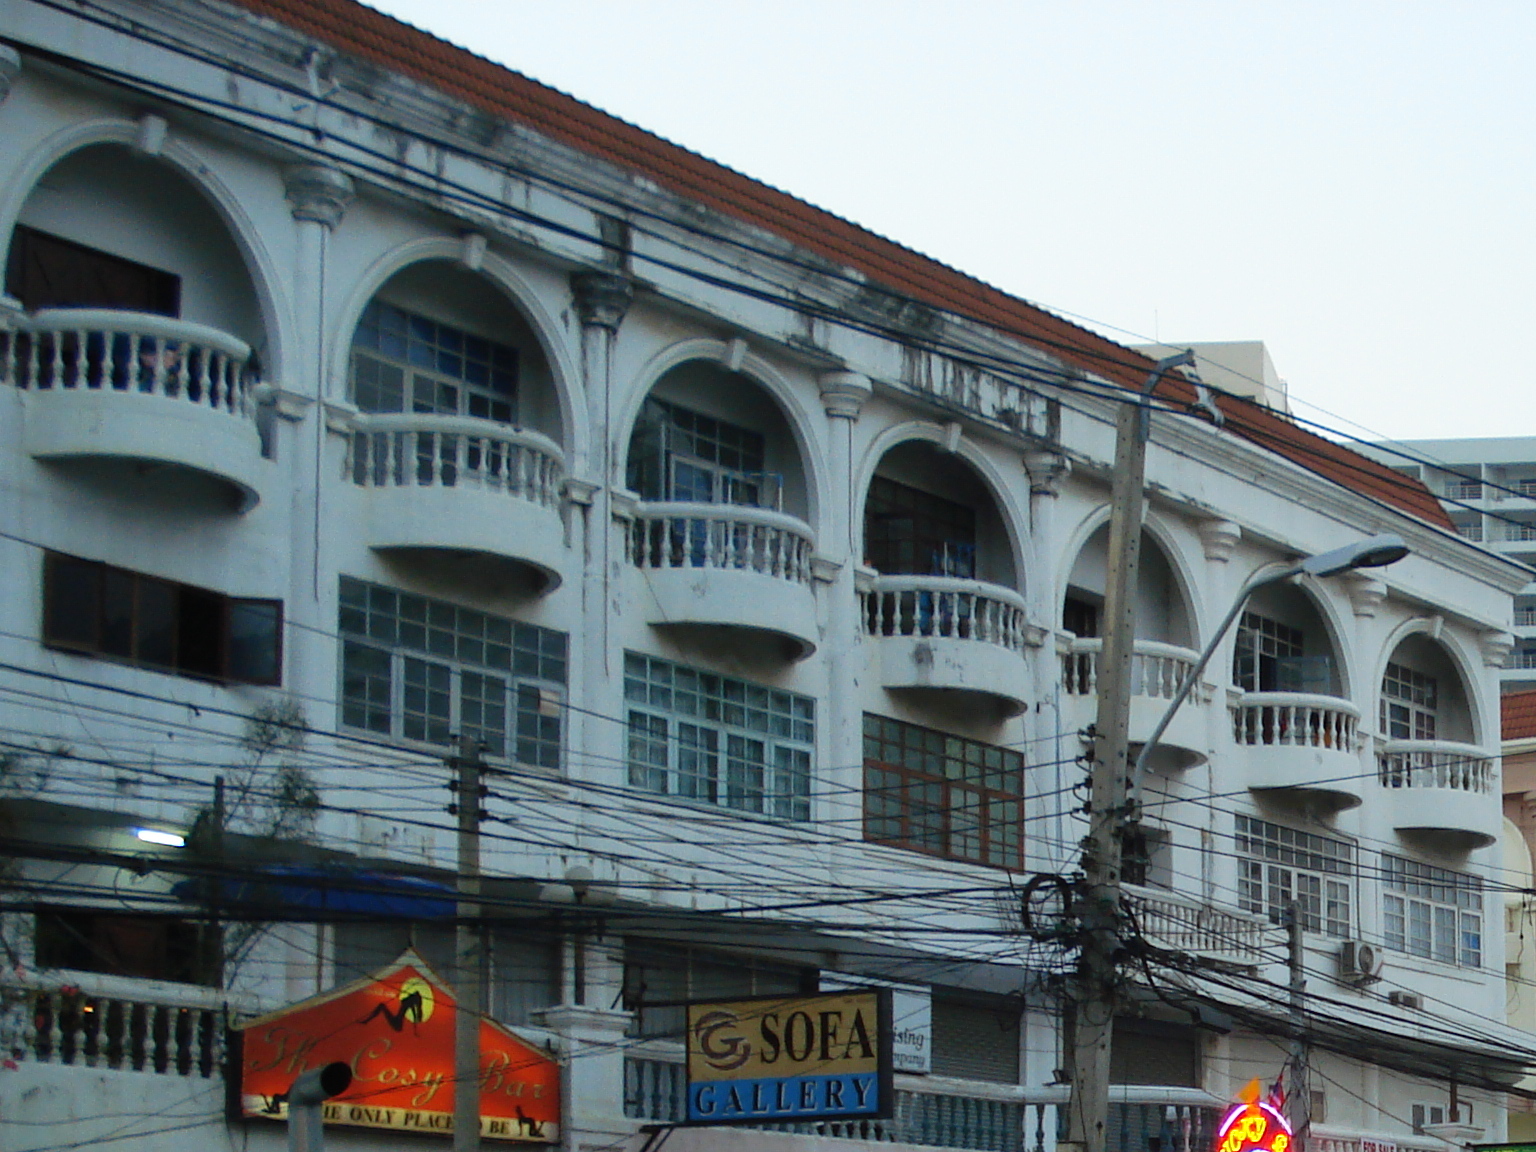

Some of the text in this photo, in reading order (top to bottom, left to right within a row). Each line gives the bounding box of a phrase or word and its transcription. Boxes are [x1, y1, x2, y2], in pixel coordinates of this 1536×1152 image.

[761, 1008, 875, 1063] SOFA
[350, 1037, 446, 1107] Cosy
[477, 1050, 547, 1100] Bar
[350, 1102, 396, 1125] ONLY
[489, 1119, 511, 1136] BE
[695, 1077, 873, 1117] GALLERY
